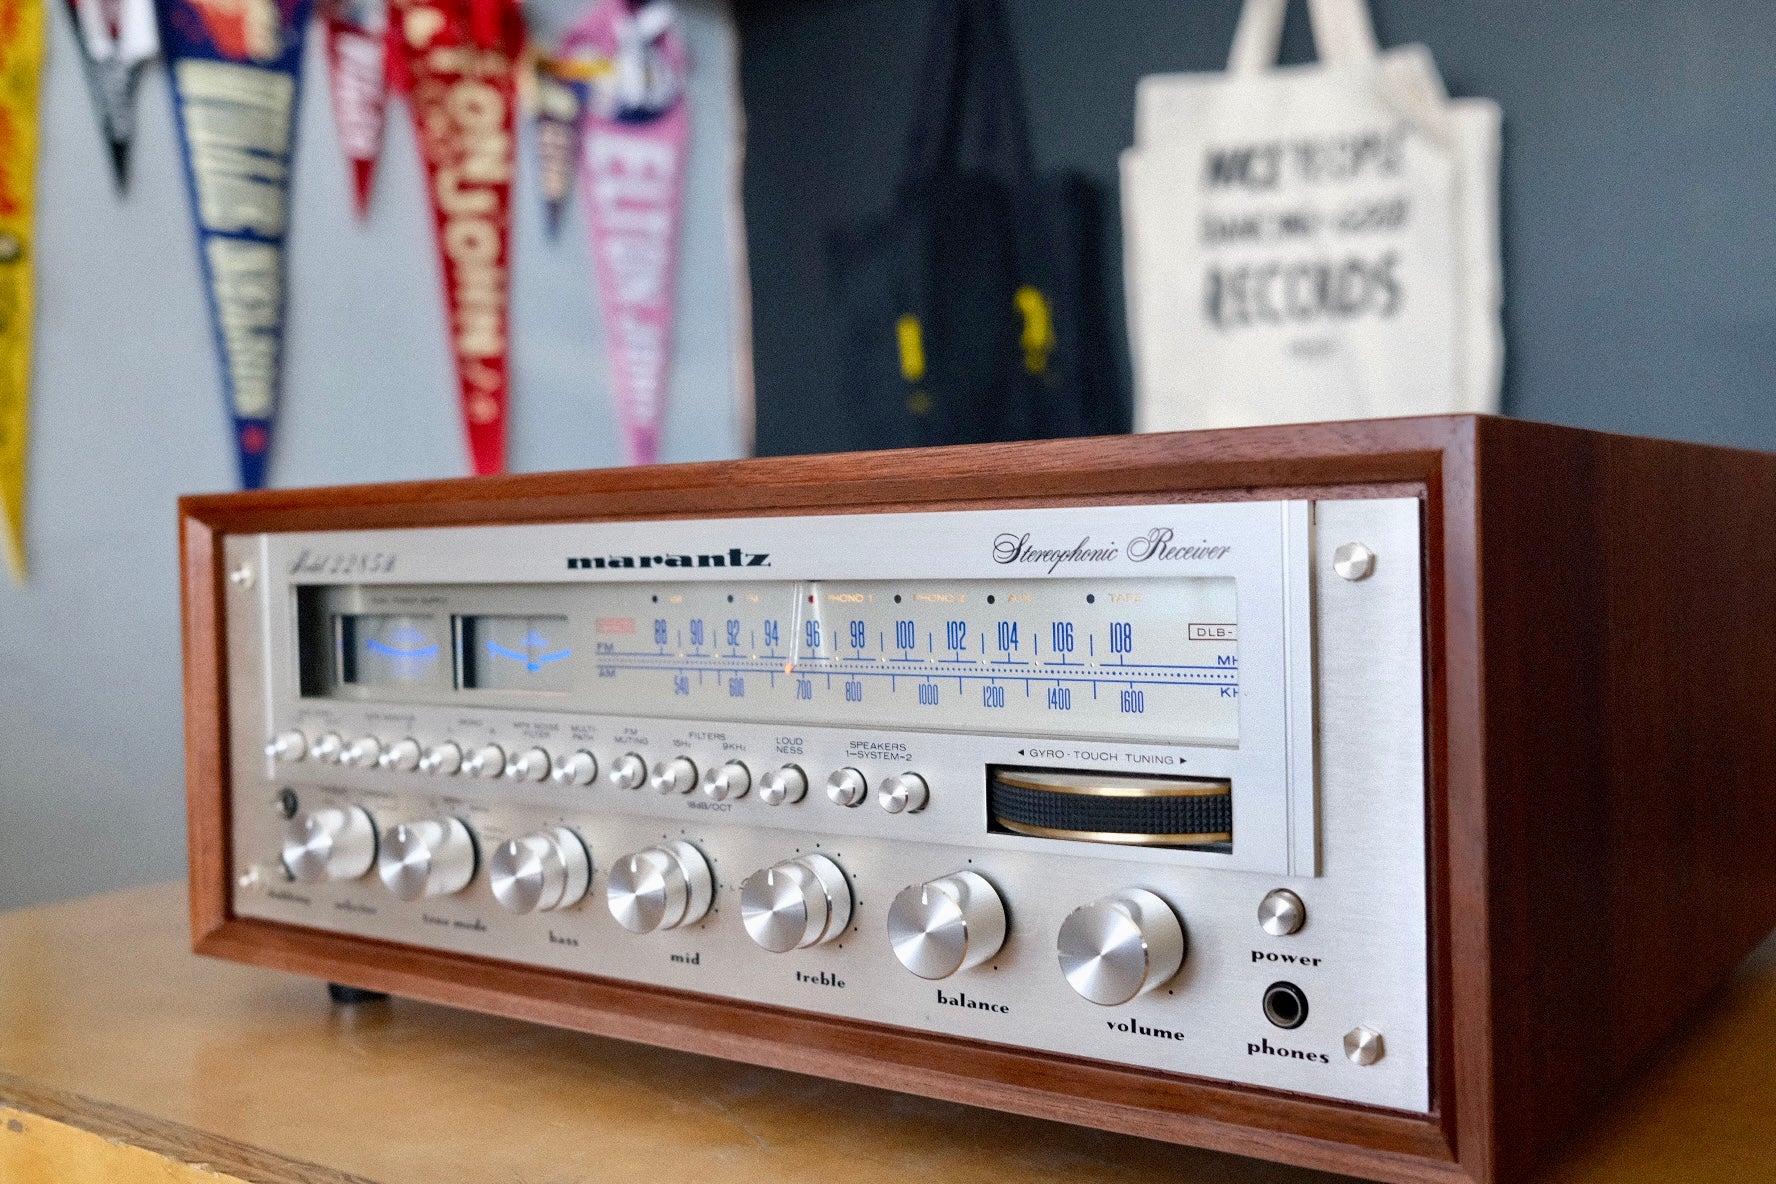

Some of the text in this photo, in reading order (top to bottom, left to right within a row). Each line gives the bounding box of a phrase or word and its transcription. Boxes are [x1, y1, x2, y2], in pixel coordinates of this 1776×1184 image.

[1207, 251, 1403, 330] RECORDS
[567, 548, 771, 570] marantz
[993, 528, 1231, 575] Stereophonic Receiver
[690, 619, 704, 646] 90
[726, 619, 741, 646] 92
[764, 620, 779, 647] 94
[806, 620, 821, 647] 96
[850, 621, 865, 648] 98
[895, 620, 915, 649] 100
[946, 621, 967, 650] 102
[998, 621, 1019, 651] 104
[1052, 622, 1074, 652] 106
[1110, 622, 1132, 653] 108
[796, 680, 812, 700] 700
[846, 681, 862, 702] 800
[918, 684, 939, 705] 1000
[983, 686, 1005, 708] 1200
[1048, 688, 1071, 710] 1400
[1120, 690, 1144, 713] 1600
[689, 731, 727, 742] FILTERS
[776, 737, 804, 746] LOUD
[850, 740, 907, 752] SPEAKERS
[776, 745, 804, 755] NESS
[1124, 753, 1174, 765] TUNING
[549, 929, 579, 947] bass
[670, 951, 701, 966] mid
[1251, 949, 1322, 967] power
[796, 970, 846, 989] treble
[936, 990, 1010, 1014] balance
[1107, 1018, 1185, 1041] volume
[1247, 1038, 1330, 1064] phones
